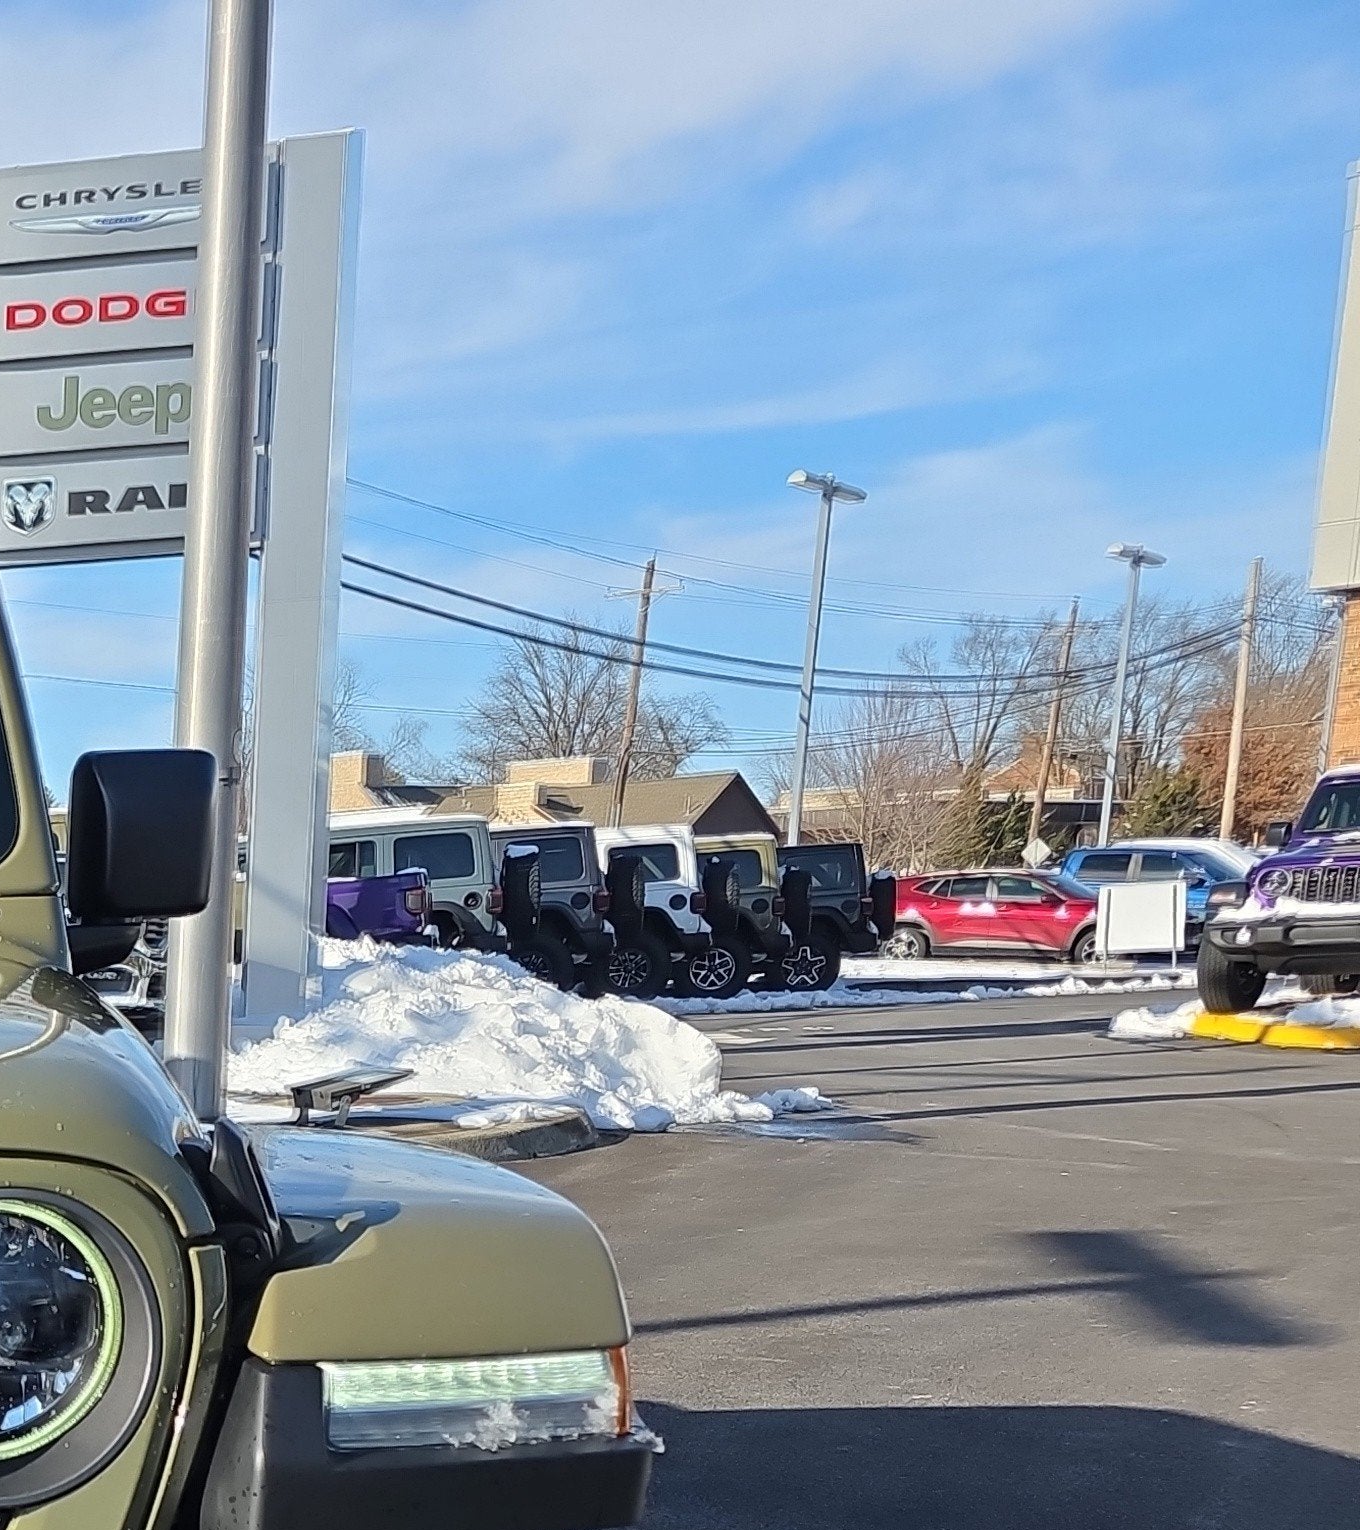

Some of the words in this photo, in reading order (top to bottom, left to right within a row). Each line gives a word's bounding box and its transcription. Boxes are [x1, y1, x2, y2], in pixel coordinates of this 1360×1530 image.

[14, 178, 203, 211] CHRYSLE
[6, 290, 186, 331] DODG
[37, 375, 192, 434] Jeep
